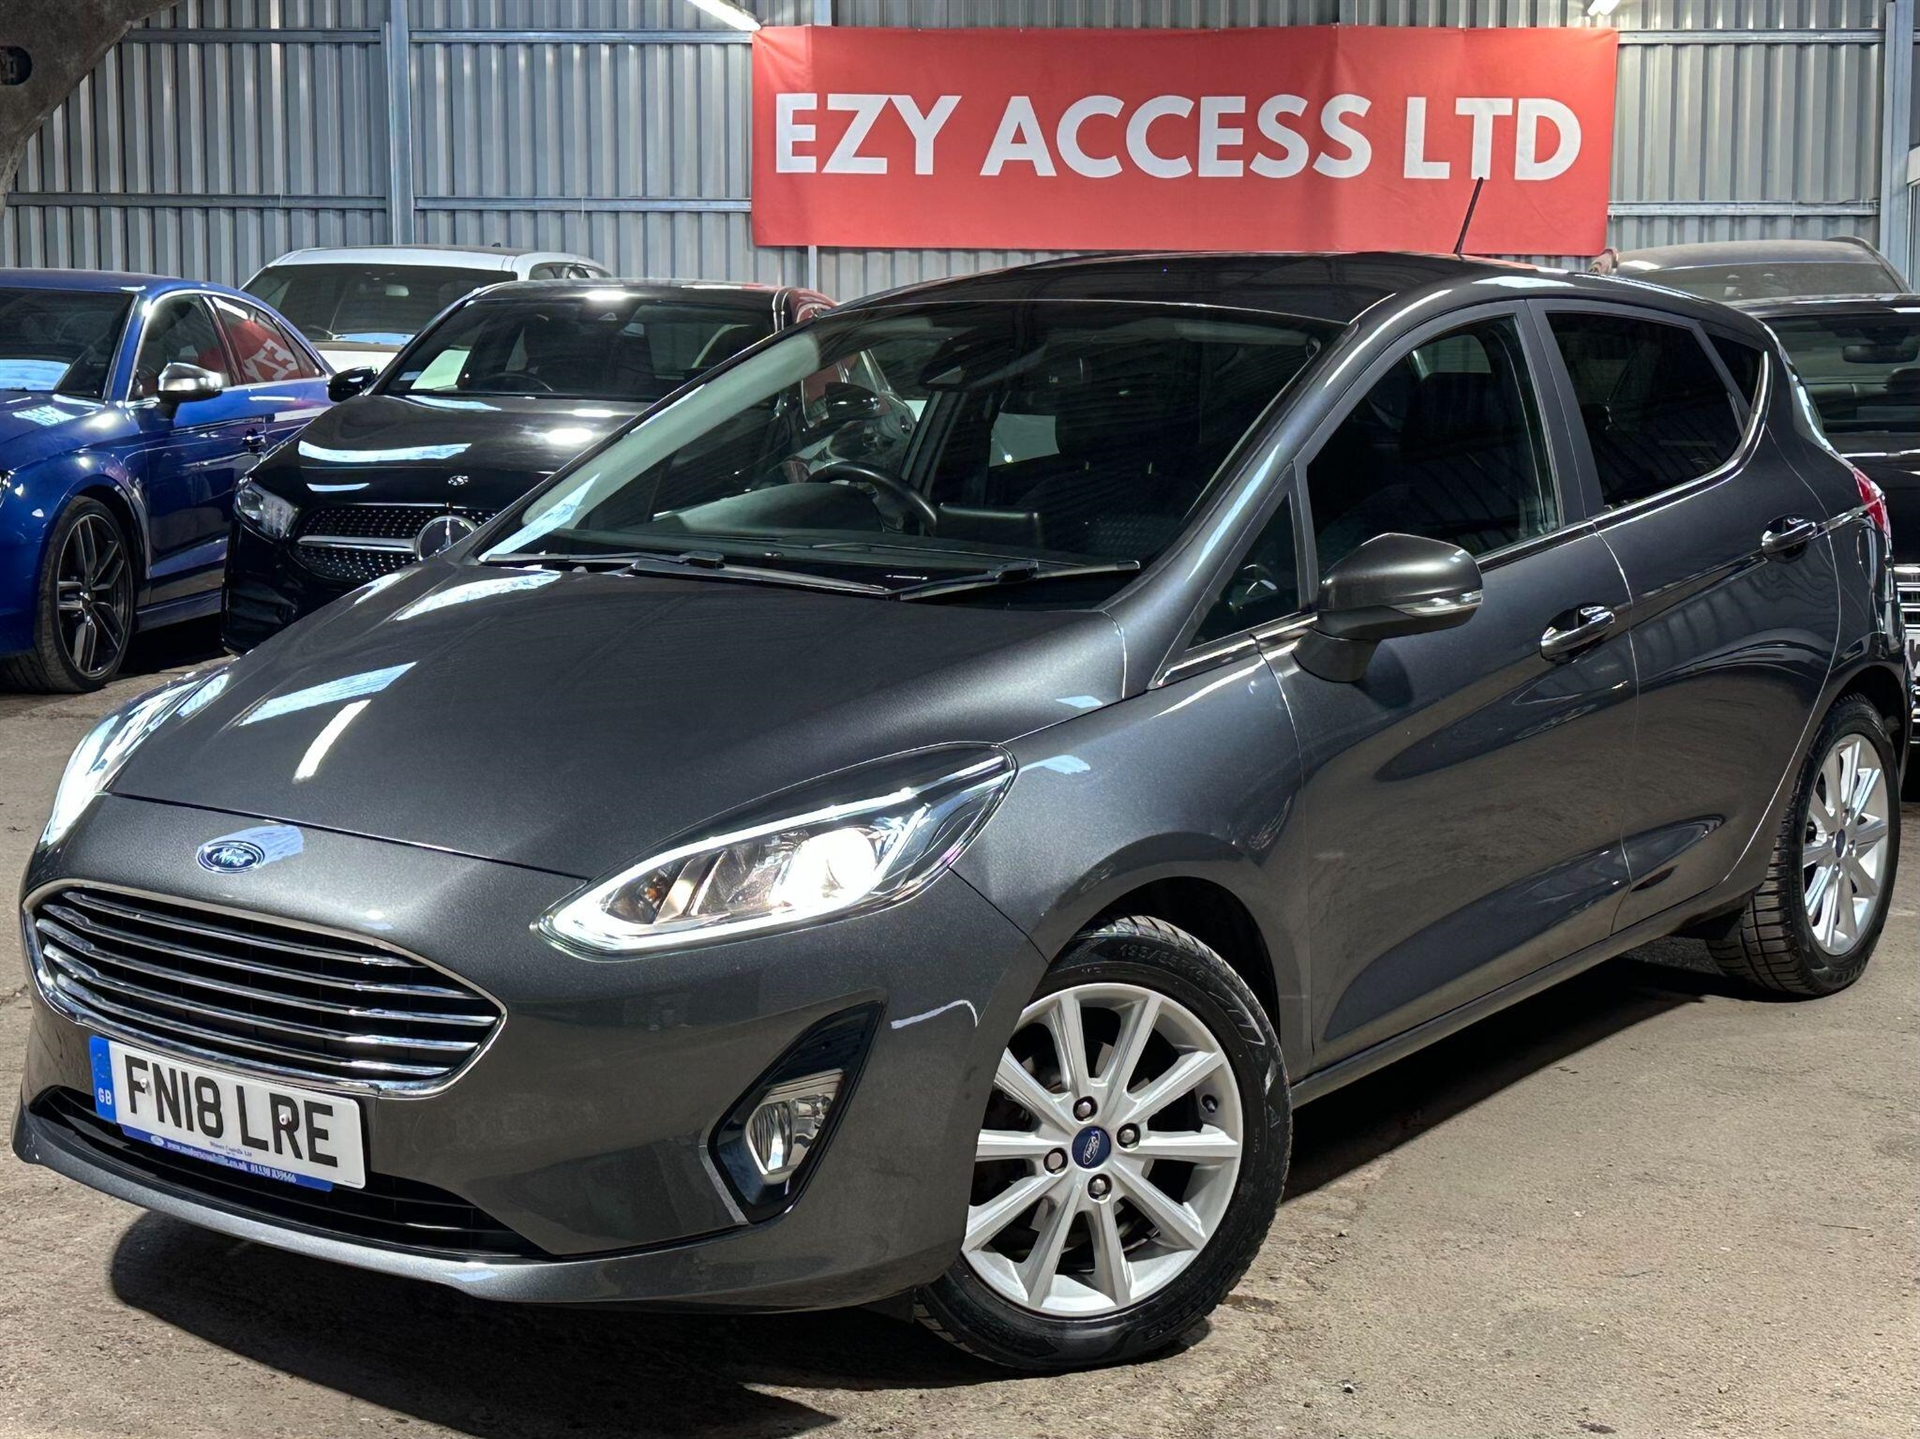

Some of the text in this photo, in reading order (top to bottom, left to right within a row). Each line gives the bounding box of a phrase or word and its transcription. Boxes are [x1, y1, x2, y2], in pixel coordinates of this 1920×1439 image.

[775, 93, 1582, 181] EZY ACCESS LTD
[97, 1087, 112, 1106] GB
[124, 1054, 339, 1168] FN18 LRE
